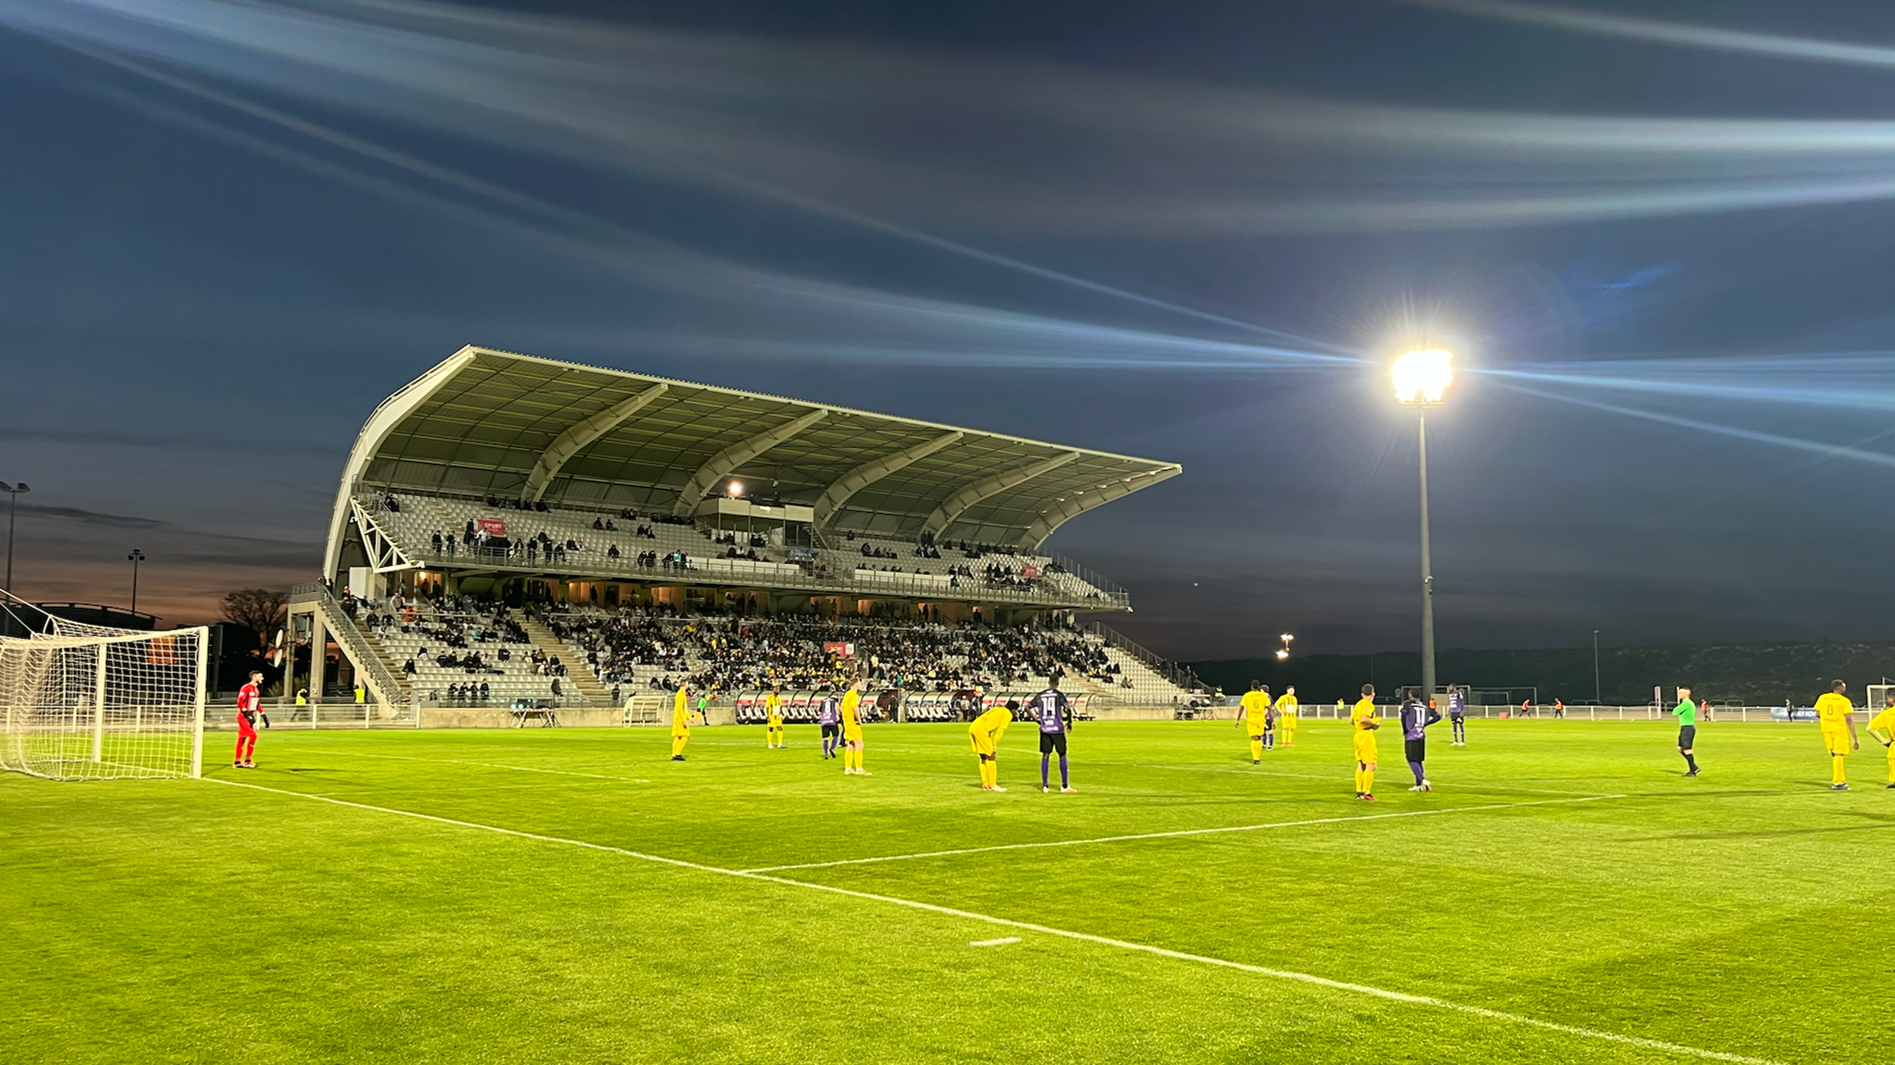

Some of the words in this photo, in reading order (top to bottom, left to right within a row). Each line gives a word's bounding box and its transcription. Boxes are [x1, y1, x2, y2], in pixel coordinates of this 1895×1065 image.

[1041, 697, 1056, 716] 14
[1253, 700, 1259, 709] 6
[1413, 706, 1426, 725] 11
